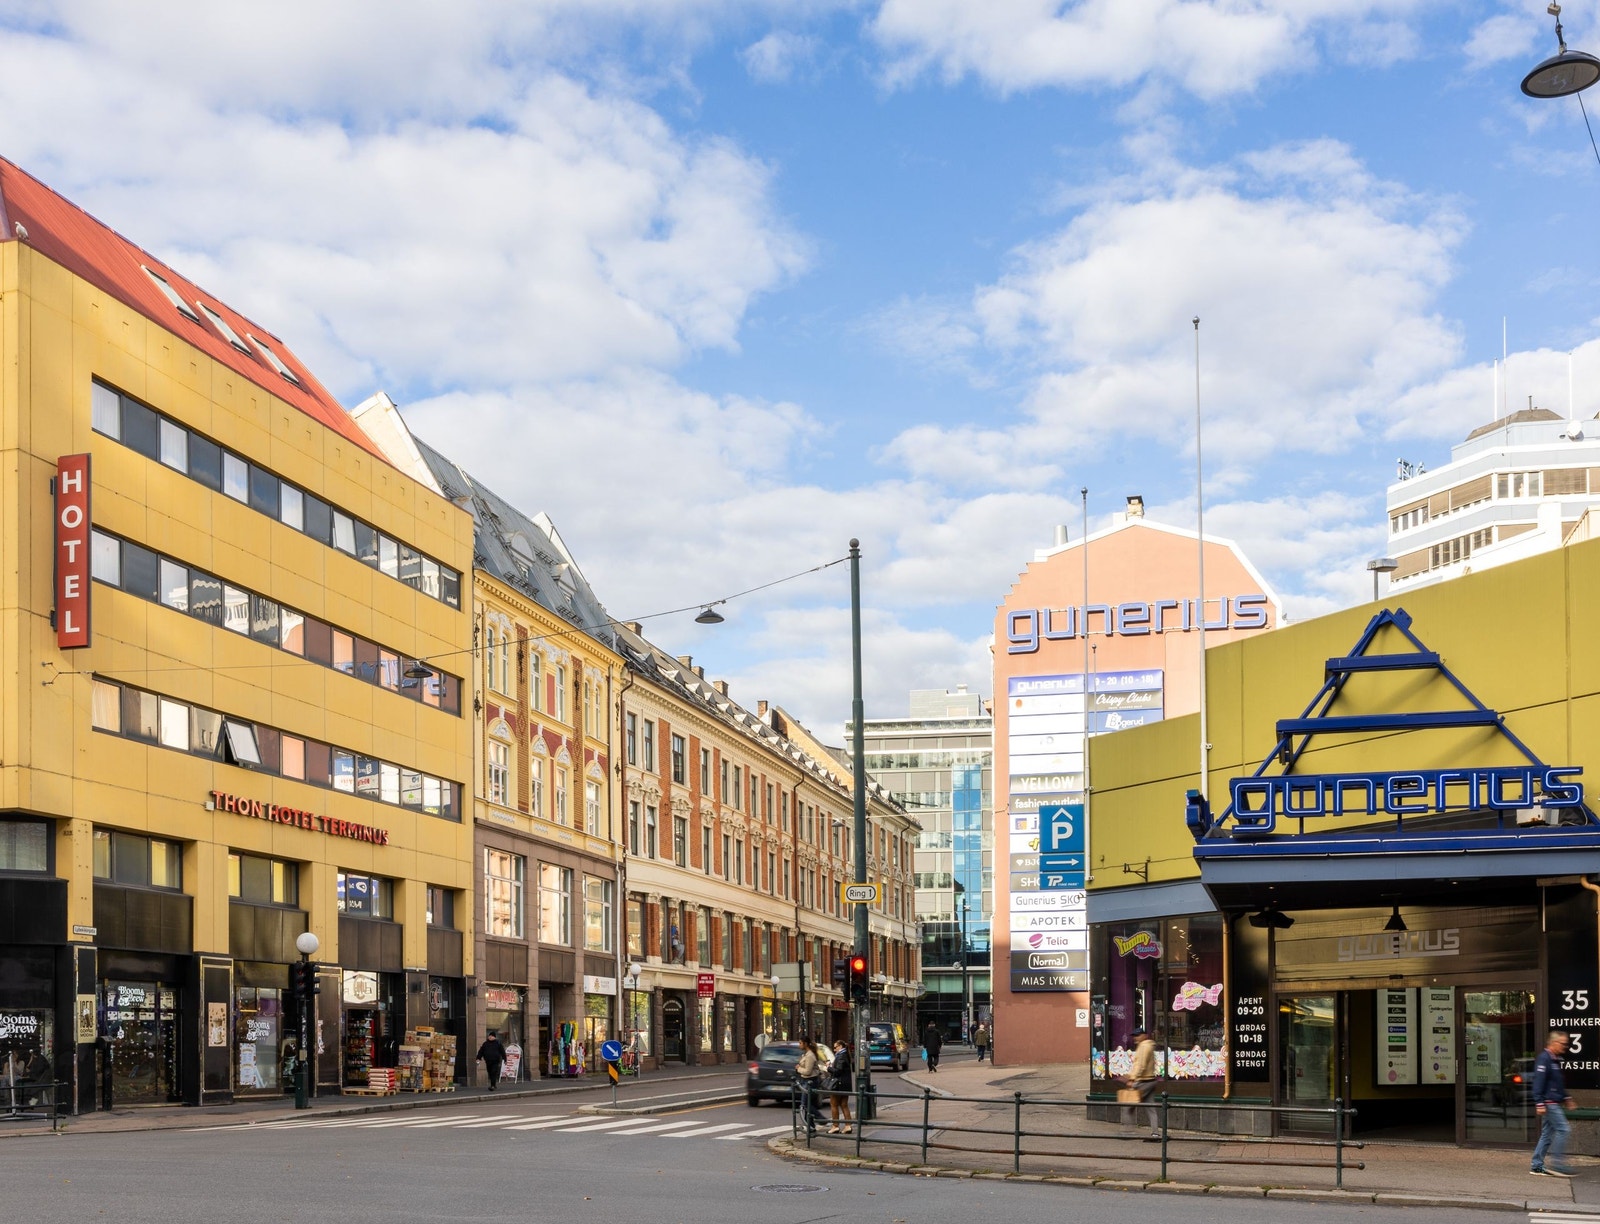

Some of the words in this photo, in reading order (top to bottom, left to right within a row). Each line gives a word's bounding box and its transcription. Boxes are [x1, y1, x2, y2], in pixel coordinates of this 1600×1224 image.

[61, 469, 83, 634] HOTEL
[1008, 594, 1268, 655] gunerius
[1017, 679, 1077, 692] gunerius
[1106, 676, 1117, 685] 20
[1120, 675, 1133, 685] (10
[1095, 693, 1125, 707] Crispy
[1126, 692, 1152, 703] Clubs
[1020, 776, 1075, 791] YELLOW
[1015, 798, 1049, 808] fashion
[1051, 796, 1080, 806] outlet
[1231, 766, 1583, 834] gunerius
[211, 789, 262, 818] THON
[268, 803, 318, 832] HOTEL
[320, 815, 390, 846] TERMINUS
[1051, 821, 1074, 850] P
[1047, 875, 1063, 886] TP
[850, 889, 866, 899] Ring
[868, 889, 872, 897] 1
[1015, 895, 1056, 905] Gunerius
[1060, 894, 1081, 905] SKO
[1030, 916, 1075, 926] APOTEK
[1046, 936, 1069, 946] Telia
[1114, 931, 1151, 955] Yummy
[1337, 928, 1460, 962] gunerius
[1033, 955, 1064, 966] Normal
[1021, 976, 1045, 986] MIAS
[1049, 976, 1075, 985] LYKKE
[1238, 996, 1263, 1005] ÅPENT
[1561, 990, 1589, 1011] 35
[1237, 1006, 1264, 1015] 09-20
[1235, 1024, 1266, 1032] LØRDAG
[1549, 1018, 1600, 1027] BUTIKKER
[6, 1024, 37, 1034] Brew
[1239, 1034, 1263, 1043] 10-18
[1569, 1033, 1582, 1054] 3
[1235, 1050, 1267, 1058] SØNDAG
[1560, 1061, 1600, 1070] TASJER
